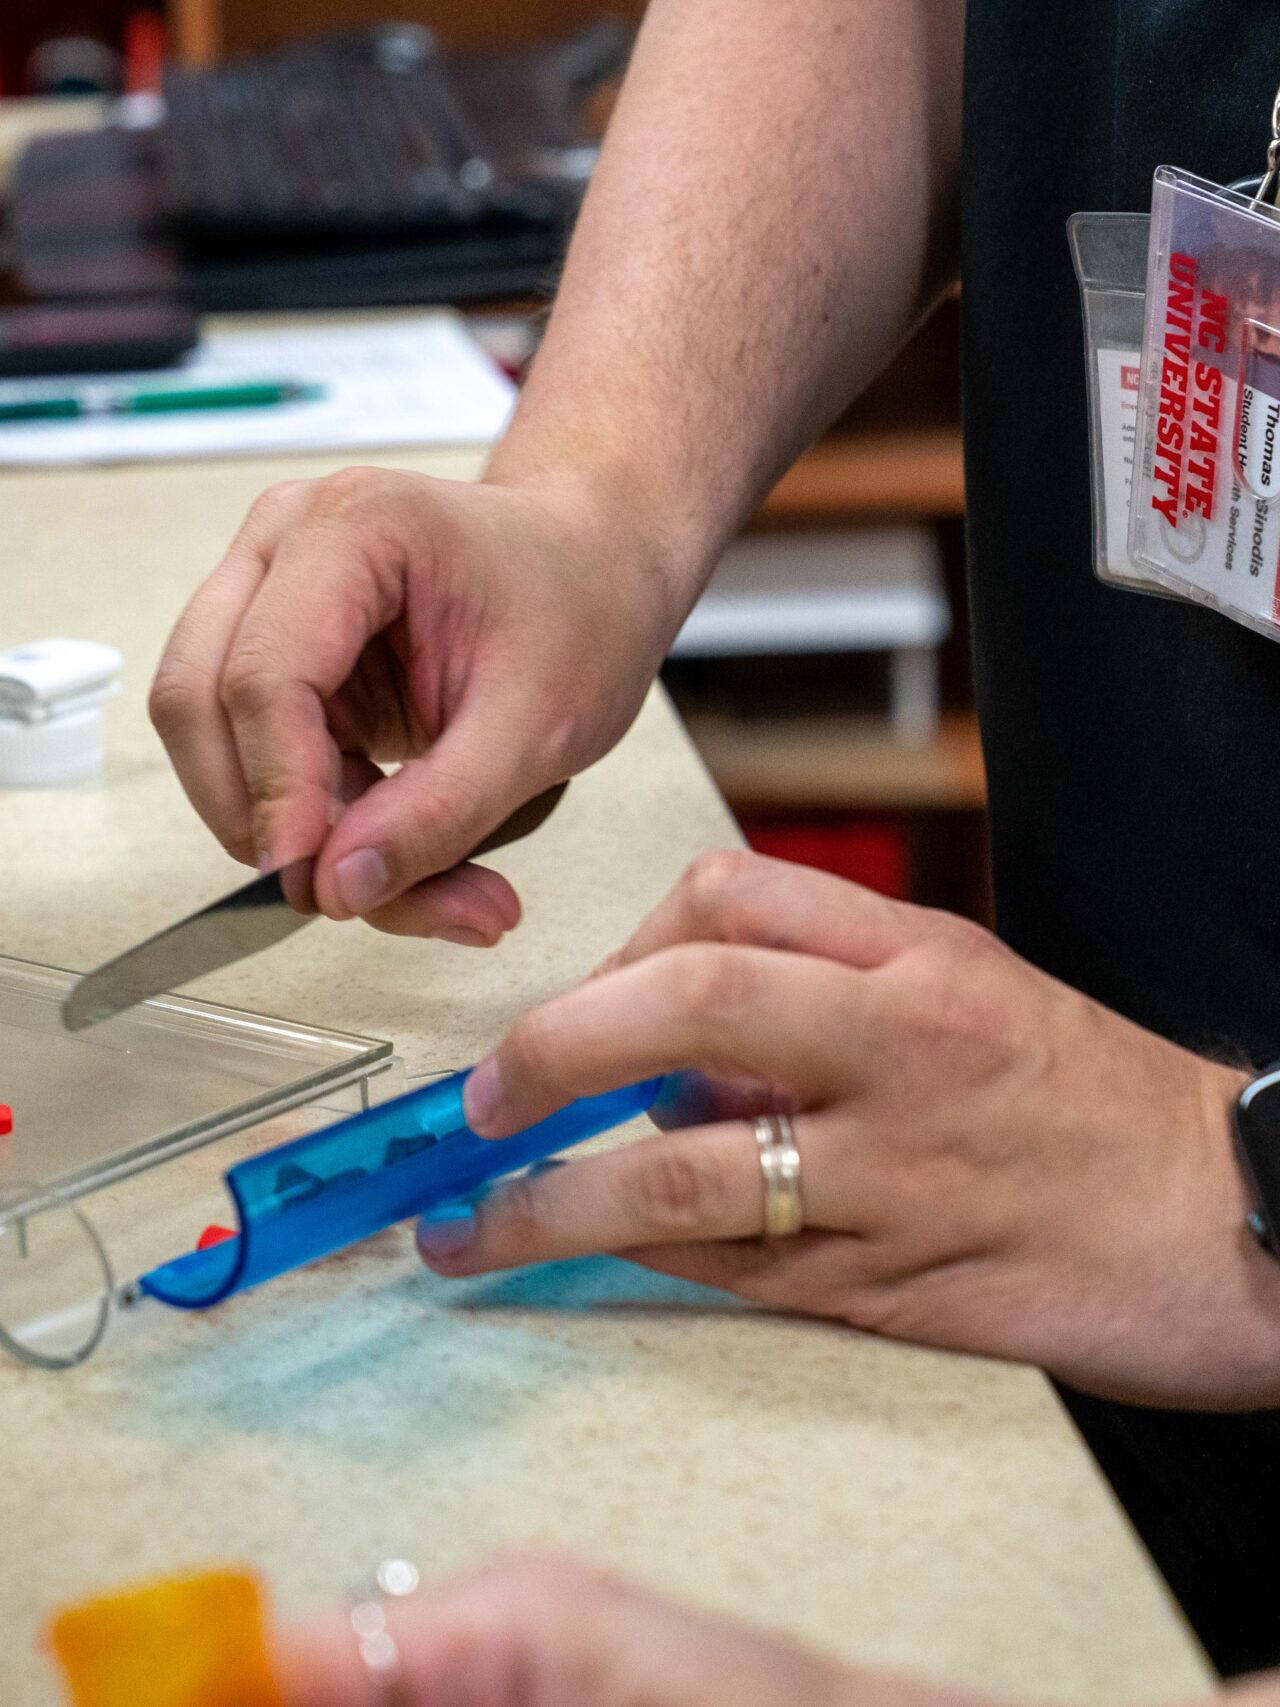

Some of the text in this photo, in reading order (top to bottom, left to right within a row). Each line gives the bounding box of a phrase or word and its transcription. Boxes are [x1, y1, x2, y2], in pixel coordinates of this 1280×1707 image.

[1152, 252, 1197, 528] UNIVERSITY
[1185, 288, 1229, 520] NC STATE
[1238, 388, 1253, 449] Student
[1261, 404, 1280, 486] Thomas
[1225, 506, 1240, 570] Services
[1250, 499, 1268, 577] Sinodis
